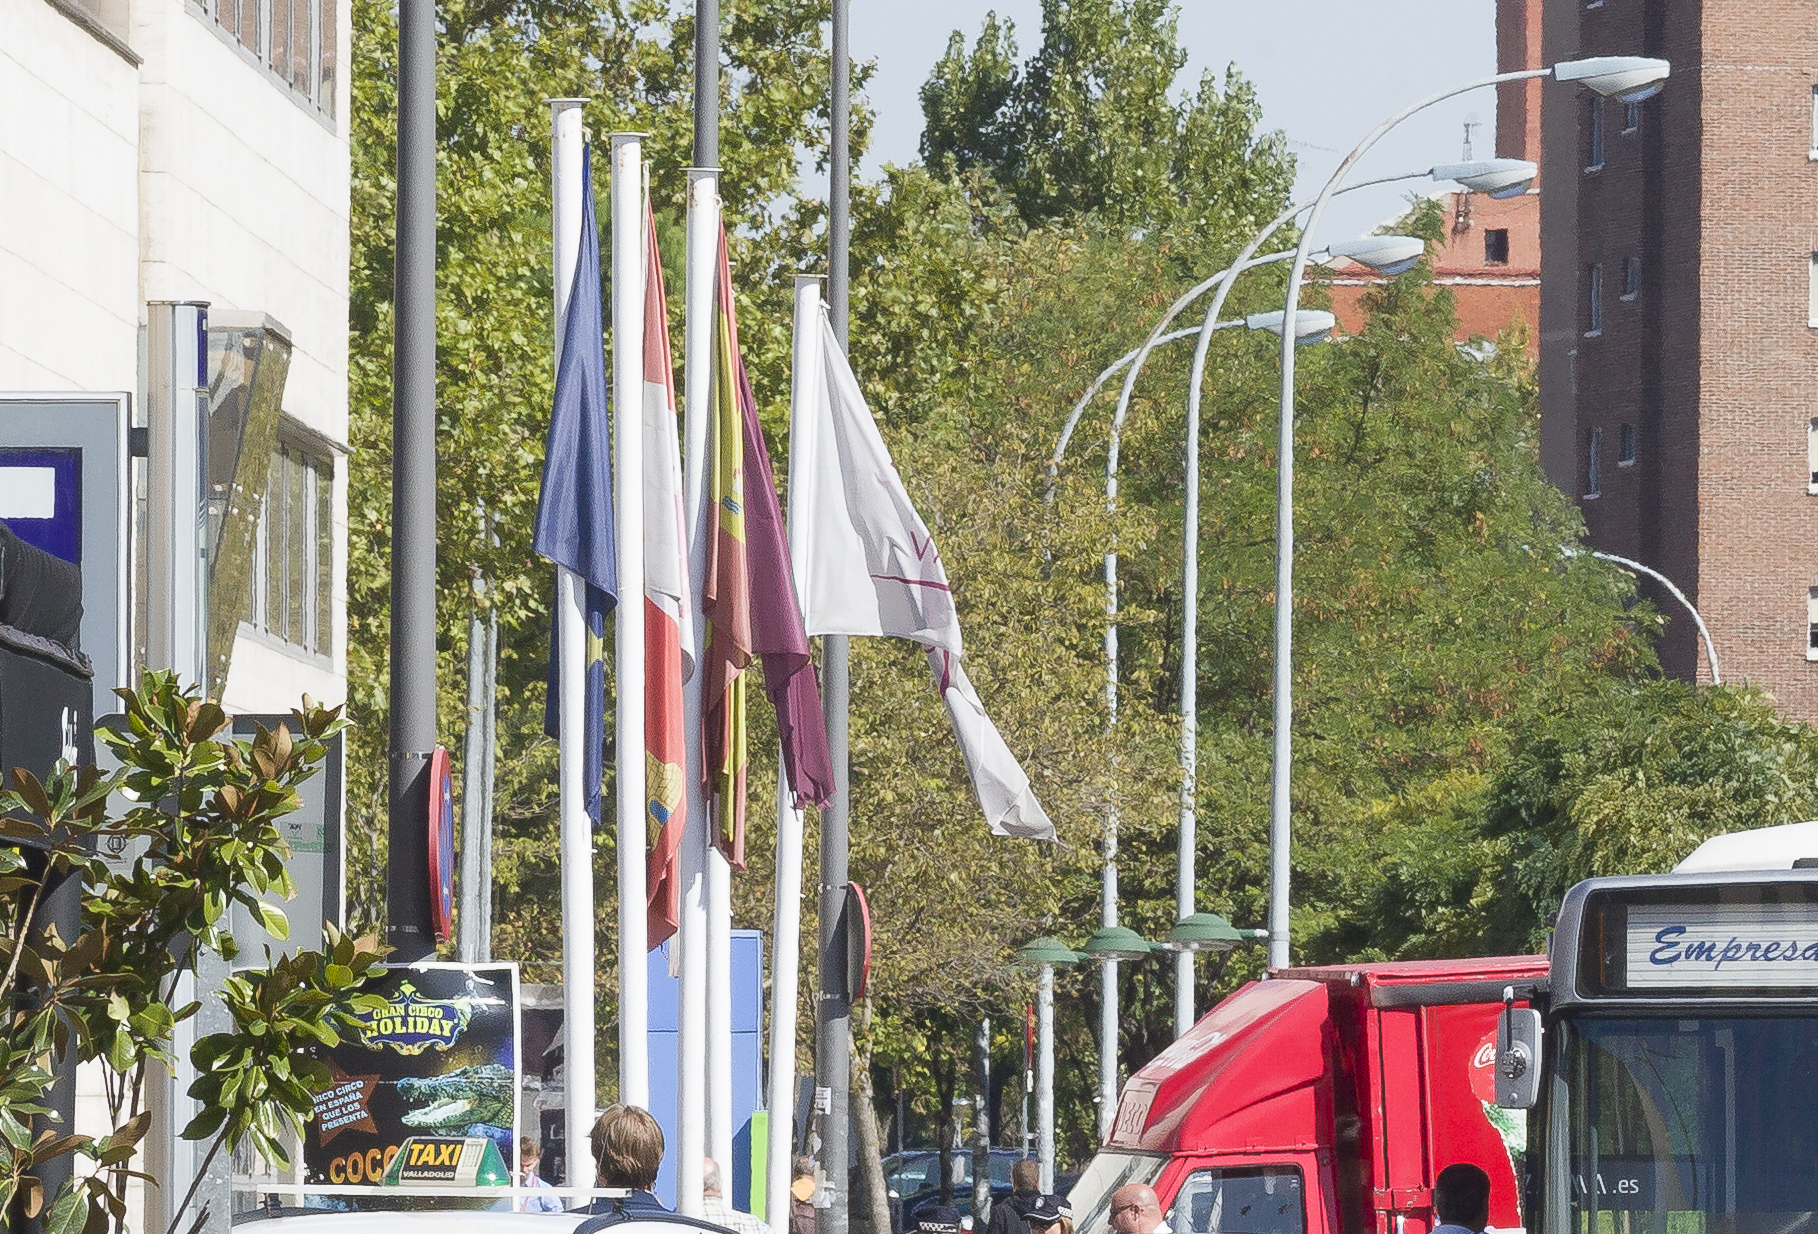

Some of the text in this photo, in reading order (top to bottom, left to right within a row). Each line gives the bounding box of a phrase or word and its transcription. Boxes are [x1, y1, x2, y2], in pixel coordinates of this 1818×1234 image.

[408, 1002, 443, 1019] CIRCO
[366, 1017, 454, 1038] HOLIDAY
[336, 1080, 364, 1096] CIRCO
[321, 1110, 368, 1132] PRESENTA
[322, 1102, 361, 1121] QUE LOS
[409, 1143, 463, 1166] TAXI
[403, 1170, 454, 1179] VALLADOLID
